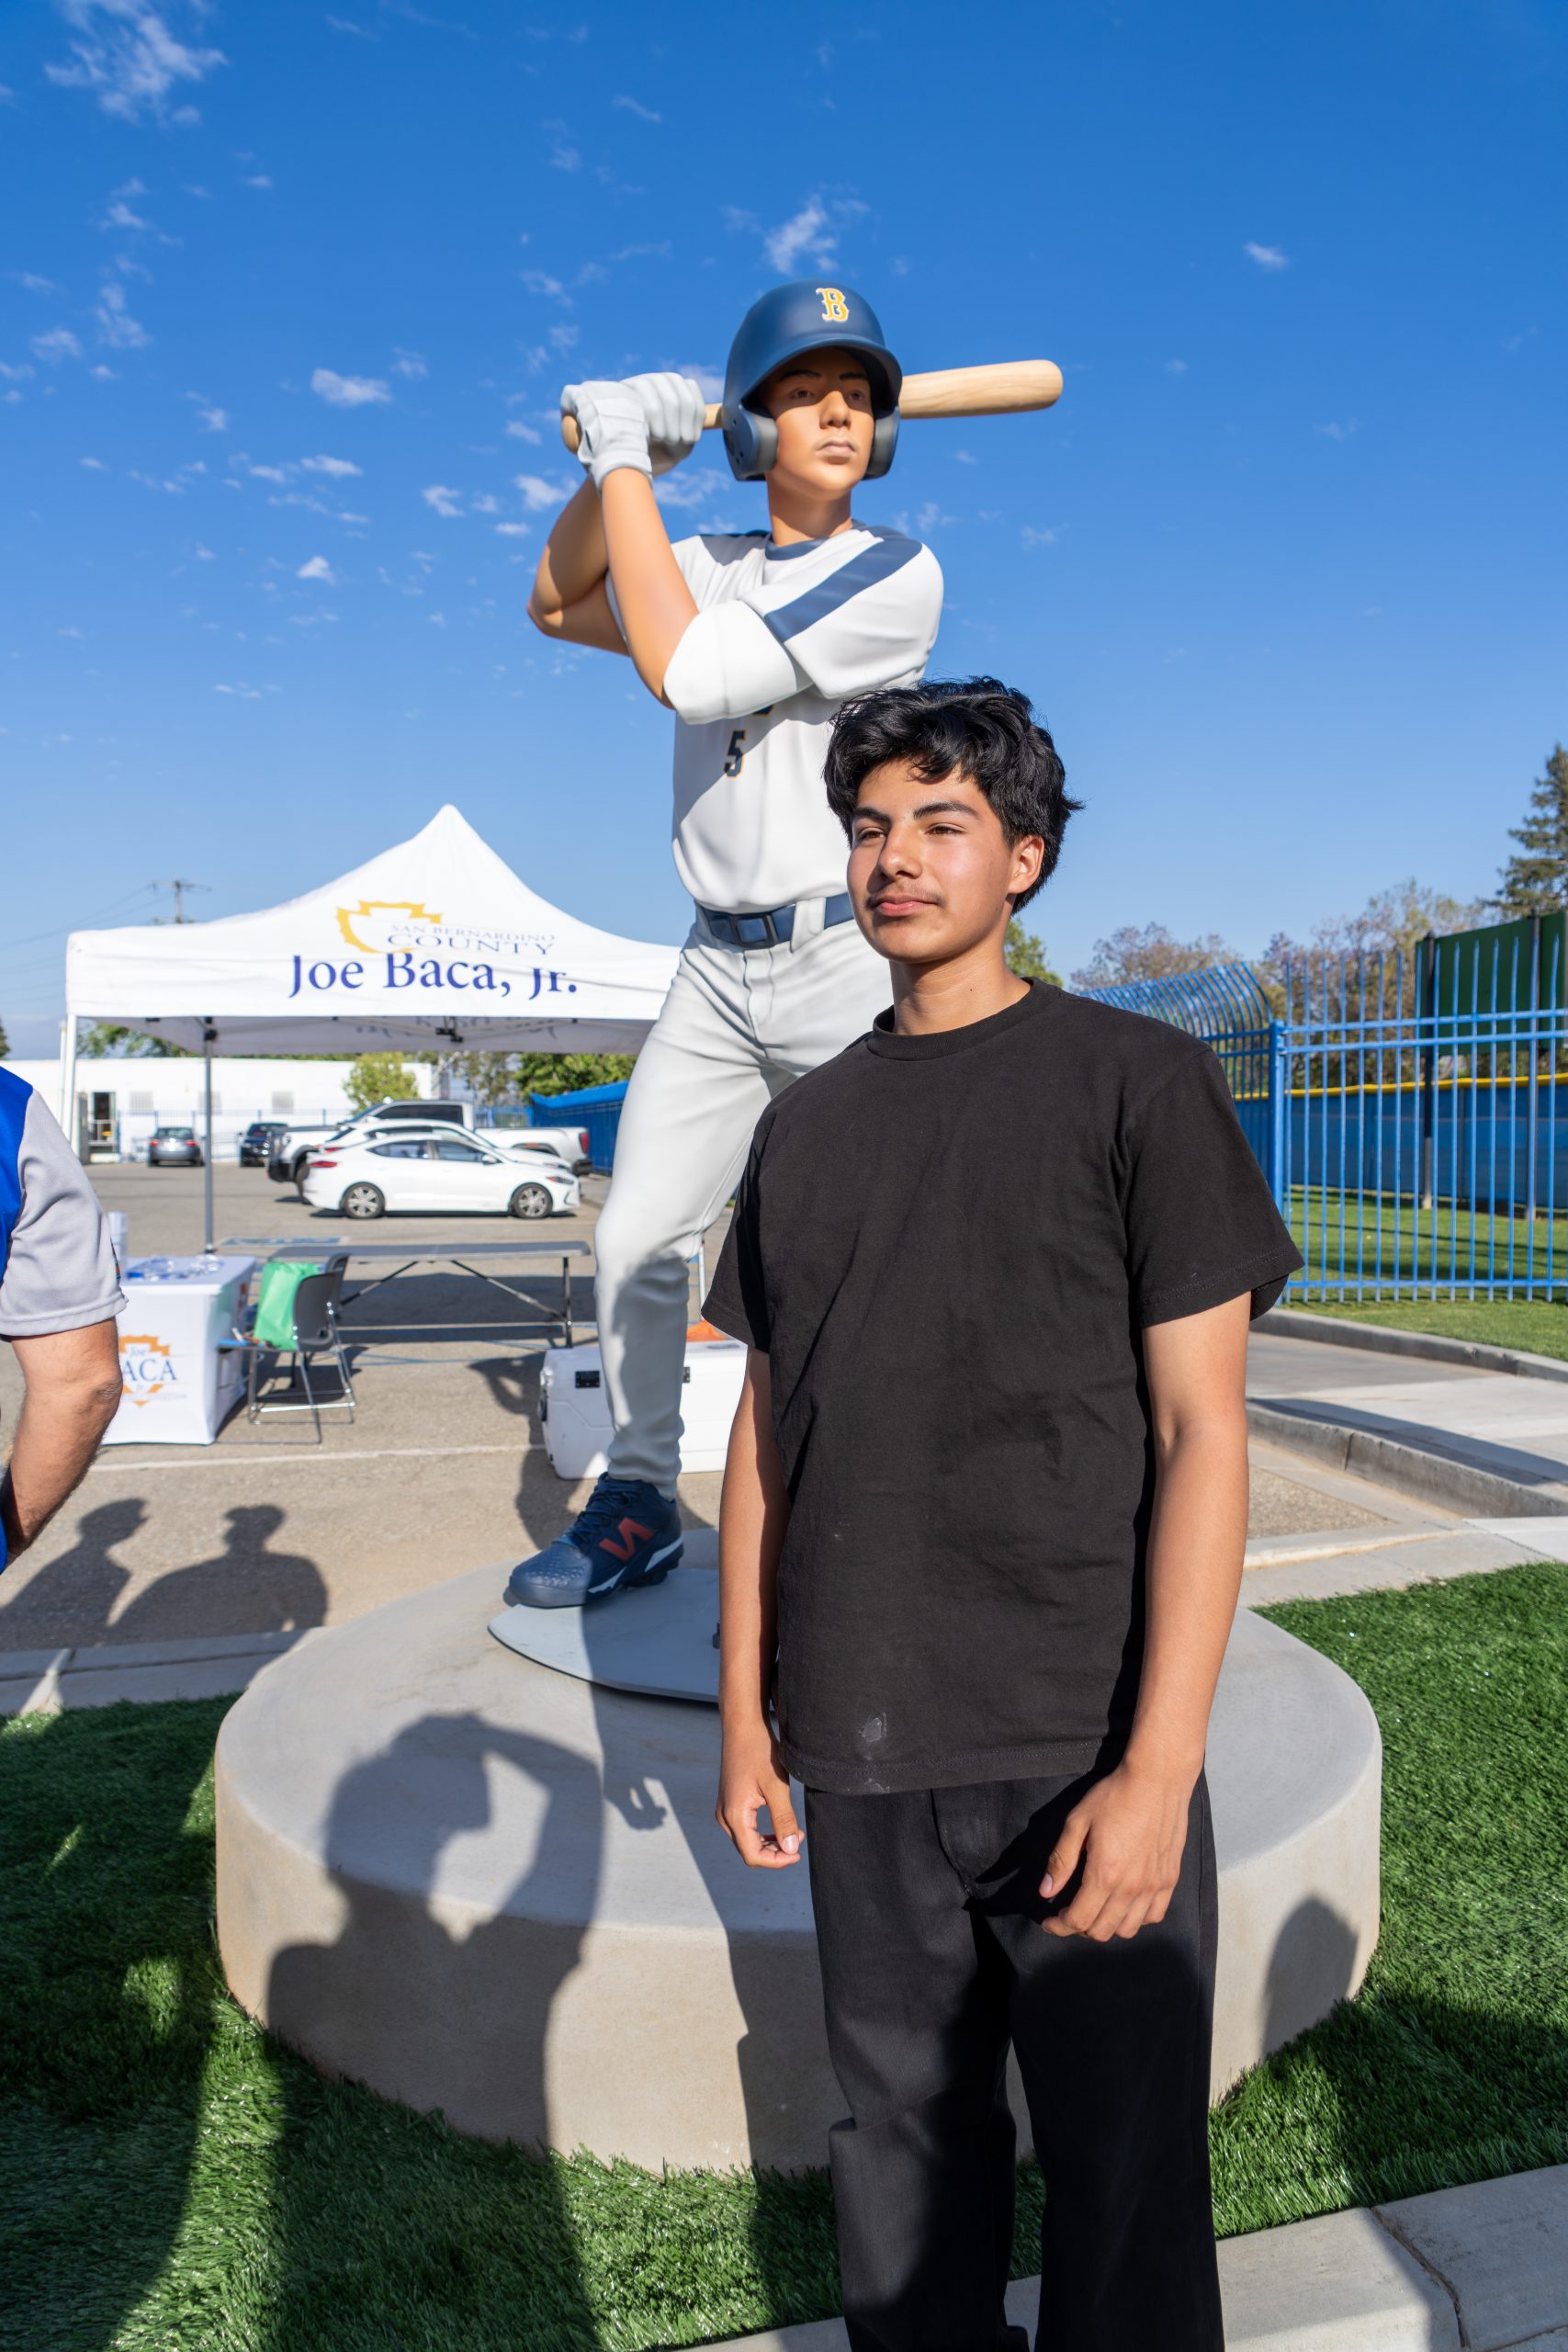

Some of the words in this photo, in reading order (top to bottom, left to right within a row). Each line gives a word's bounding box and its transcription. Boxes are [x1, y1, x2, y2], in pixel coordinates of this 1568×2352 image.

[816, 288, 850, 322] B
[724, 729, 746, 780] 5
[388, 933, 556, 956] COUNTY
[391, 924, 425, 934] SAN
[433, 927, 556, 942] BERNARDINO
[288, 955, 364, 999] Joe
[382, 953, 511, 998] Baca,
[528, 967, 578, 1001] Jr.
[122, 1358, 177, 1381] ACA
